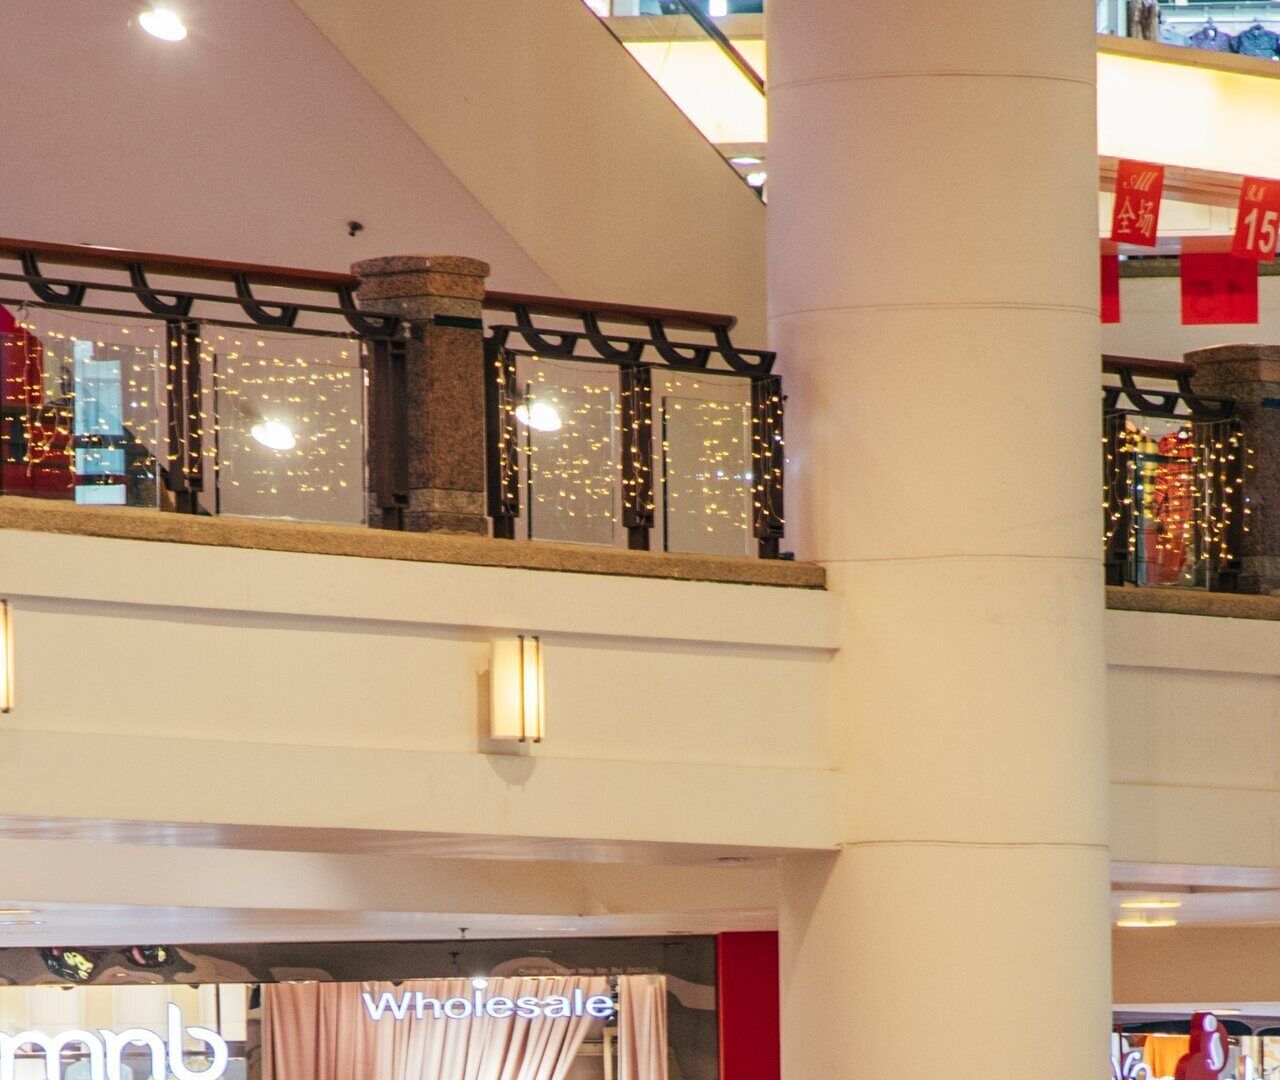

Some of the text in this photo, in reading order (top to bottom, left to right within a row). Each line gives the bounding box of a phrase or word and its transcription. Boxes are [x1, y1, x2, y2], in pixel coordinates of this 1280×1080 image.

[1117, 196, 1155, 238] 全场
[1243, 207, 1278, 253] 15
[362, 987, 616, 1021] Wholesale
